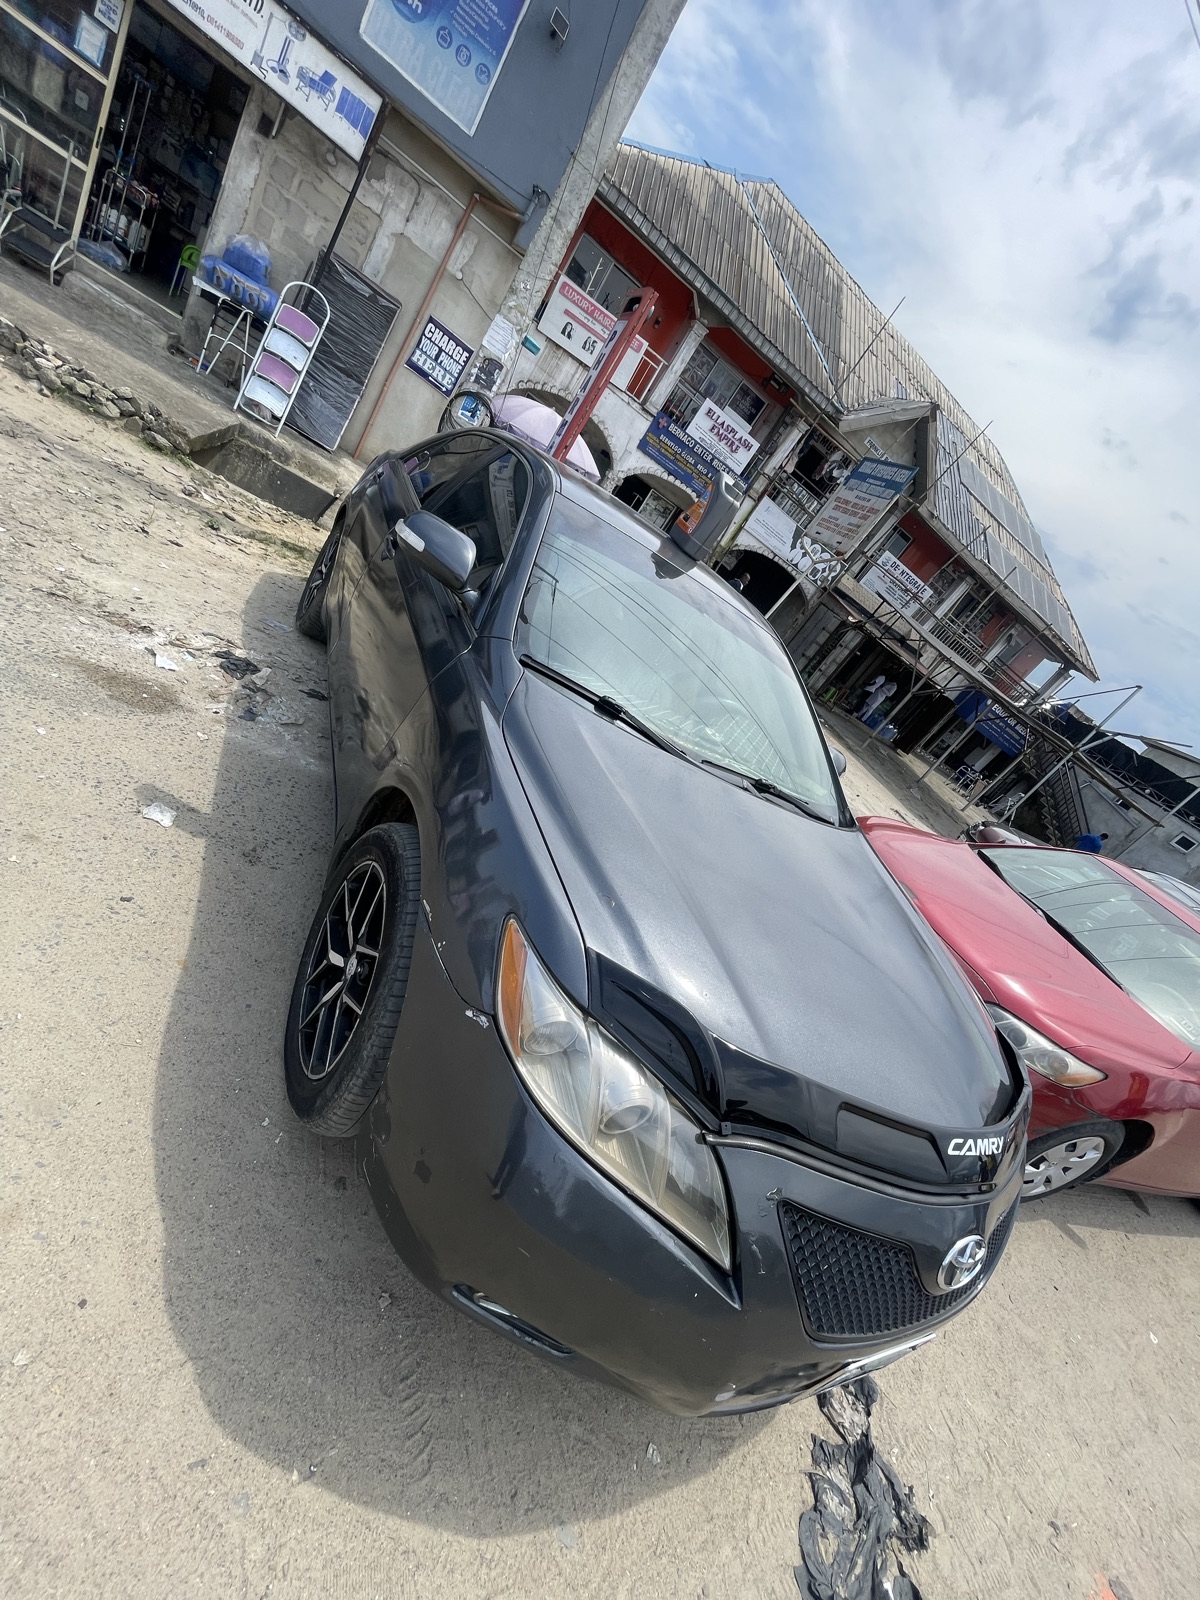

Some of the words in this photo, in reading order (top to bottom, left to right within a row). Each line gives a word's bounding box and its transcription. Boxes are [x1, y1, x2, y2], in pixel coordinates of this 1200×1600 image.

[563, 286, 594, 316] LUXURY
[419, 335, 440, 360] YOUR
[438, 351, 463, 378] PHONE
[424, 322, 470, 366] CHARGE
[411, 349, 455, 389] HERE
[668, 423, 695, 448] BERNACO
[705, 407, 754, 452] ELLASPLASH
[709, 423, 741, 454] EMPIRE
[947, 1136, 1004, 1156] CAMRY
